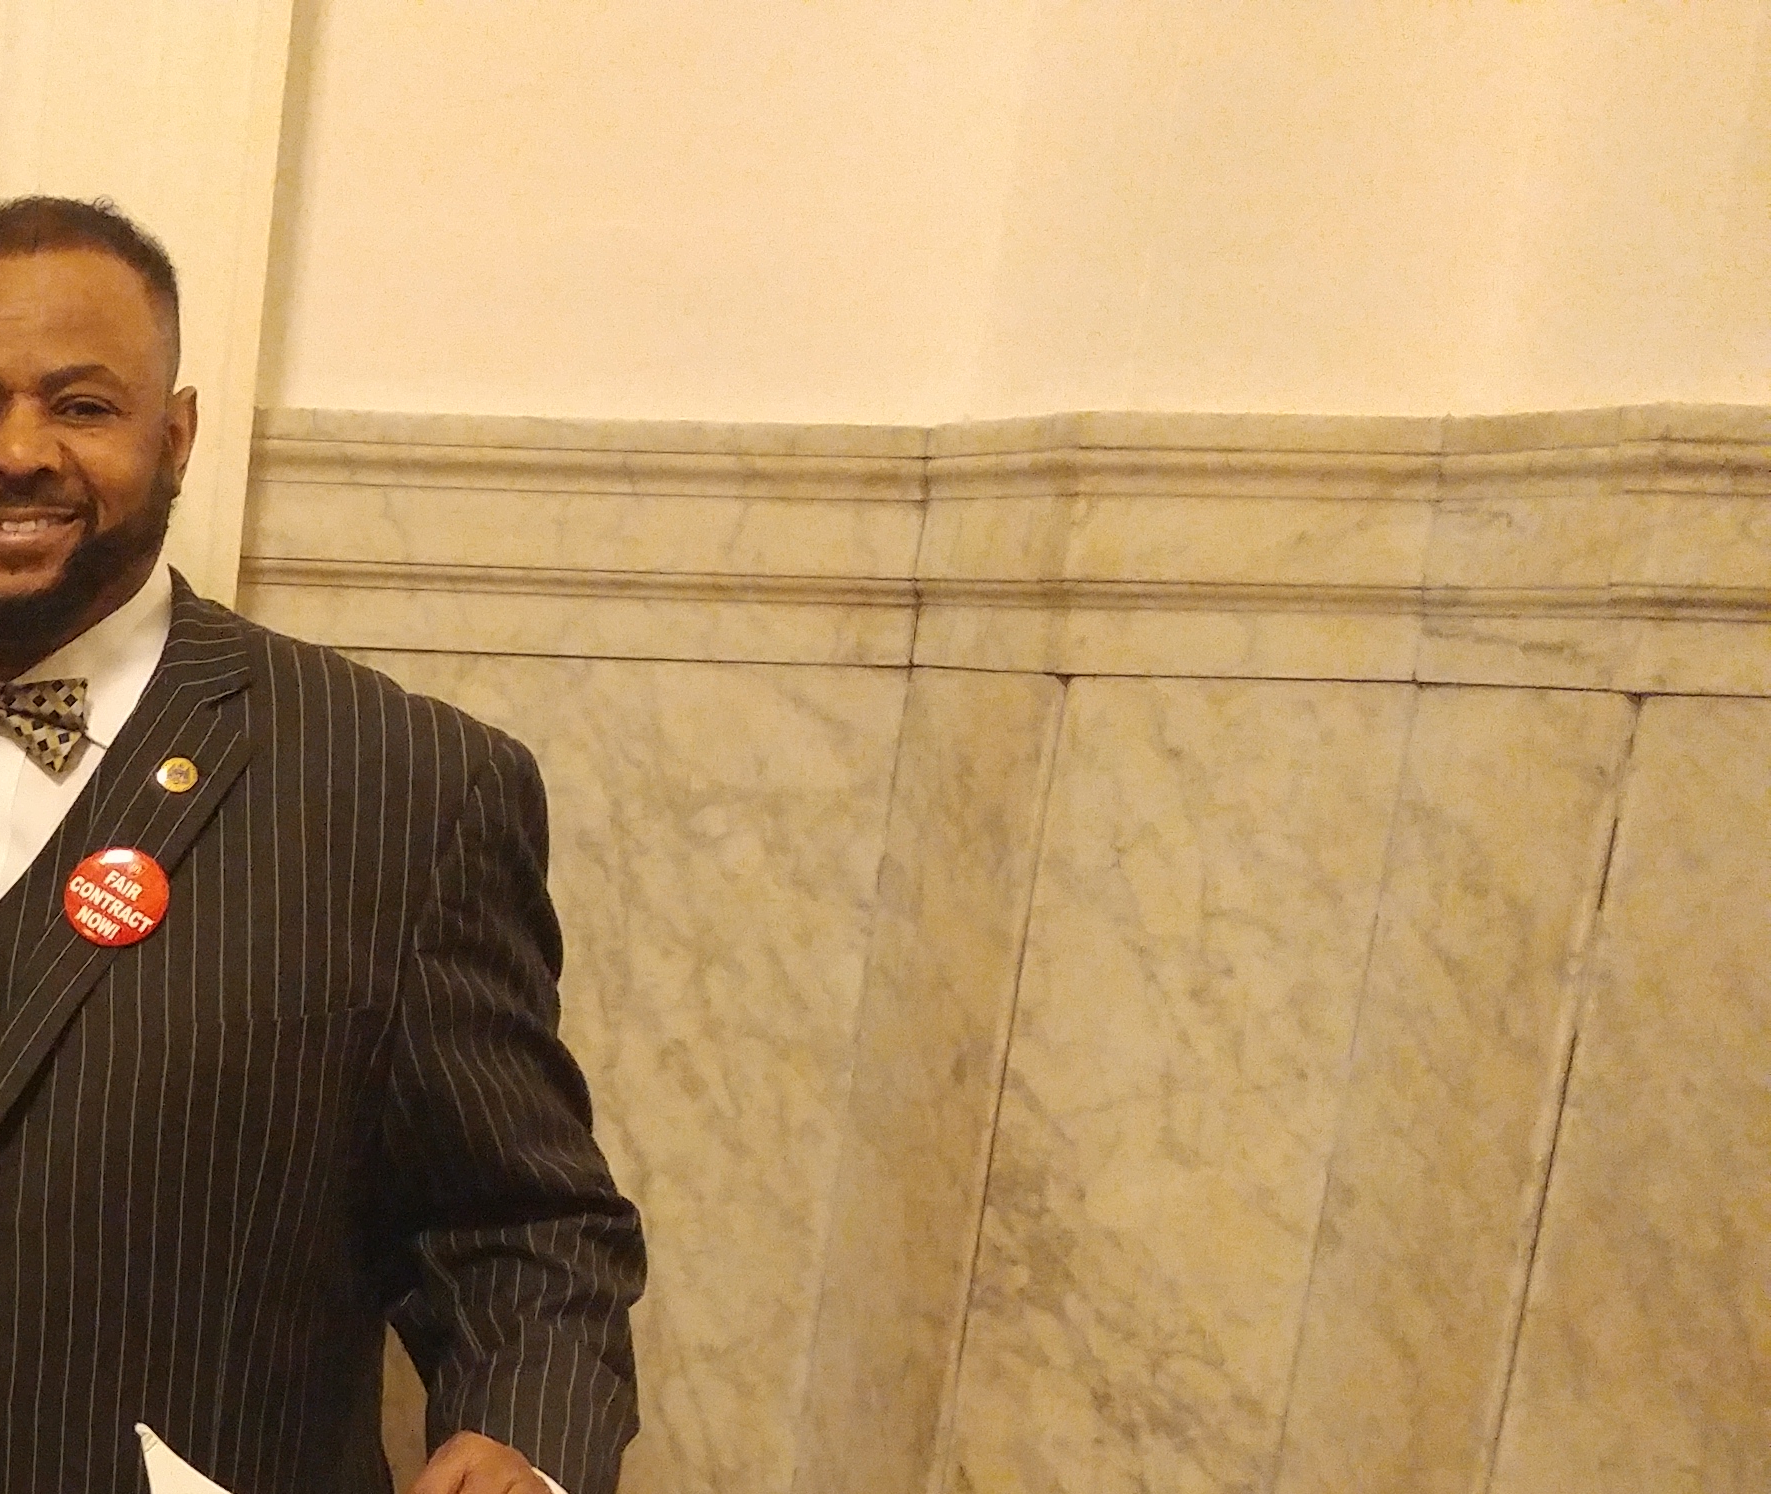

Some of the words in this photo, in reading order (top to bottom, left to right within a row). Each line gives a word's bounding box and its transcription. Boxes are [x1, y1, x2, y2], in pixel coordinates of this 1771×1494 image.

[104, 870, 142, 901] FAIR
[69, 876, 155, 934] CONTRACT
[75, 905, 121, 940] NOW!
